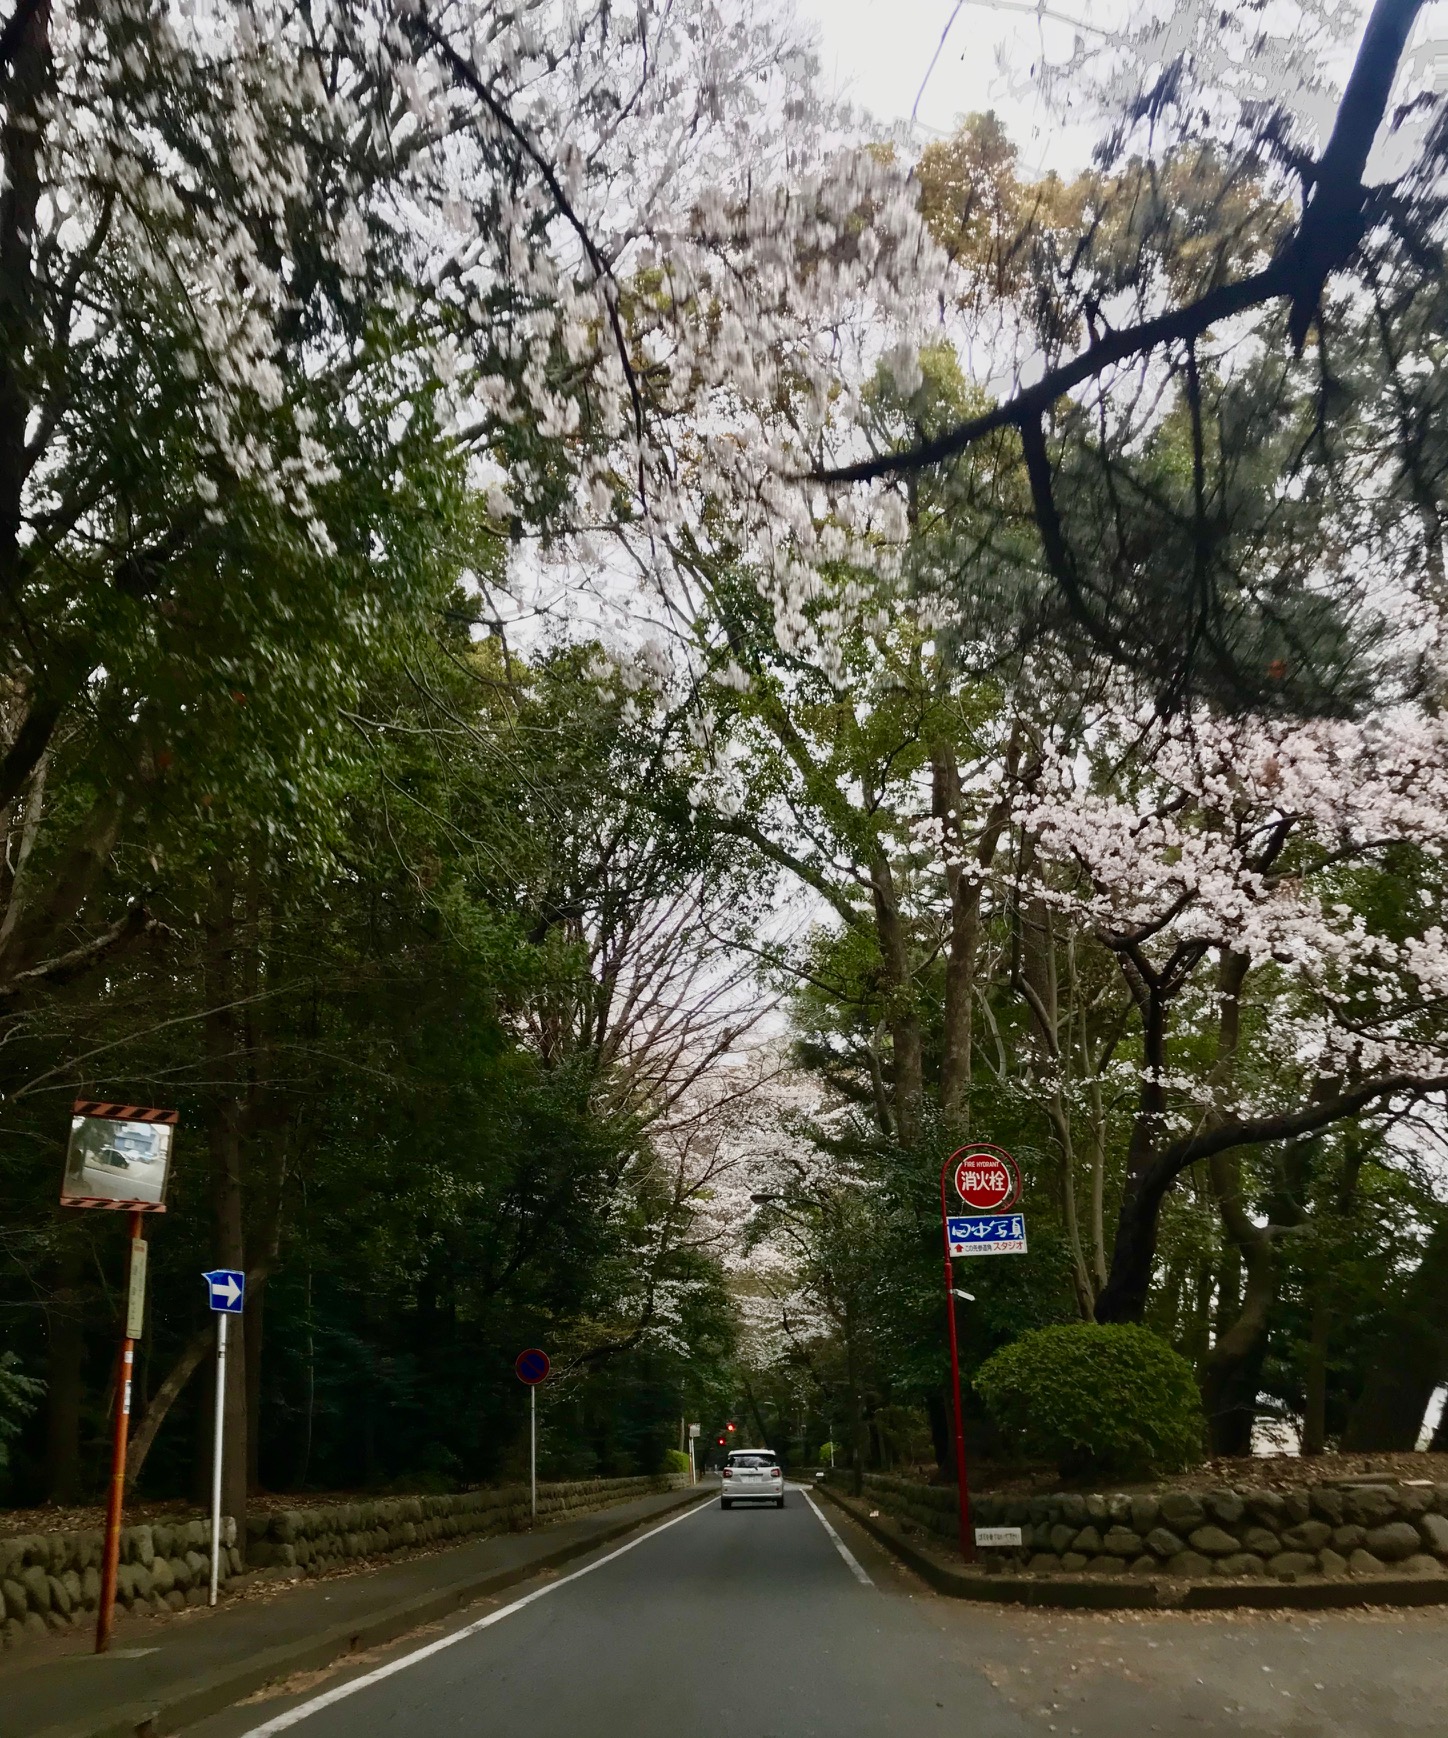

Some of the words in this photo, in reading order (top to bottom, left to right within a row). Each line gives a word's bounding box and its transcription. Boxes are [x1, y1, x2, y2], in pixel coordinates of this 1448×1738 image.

[961, 1170, 1005, 1191] 消火栓
[952, 1217, 1023, 1239] 田中写真
[993, 1241, 1023, 1250] スタジオ
